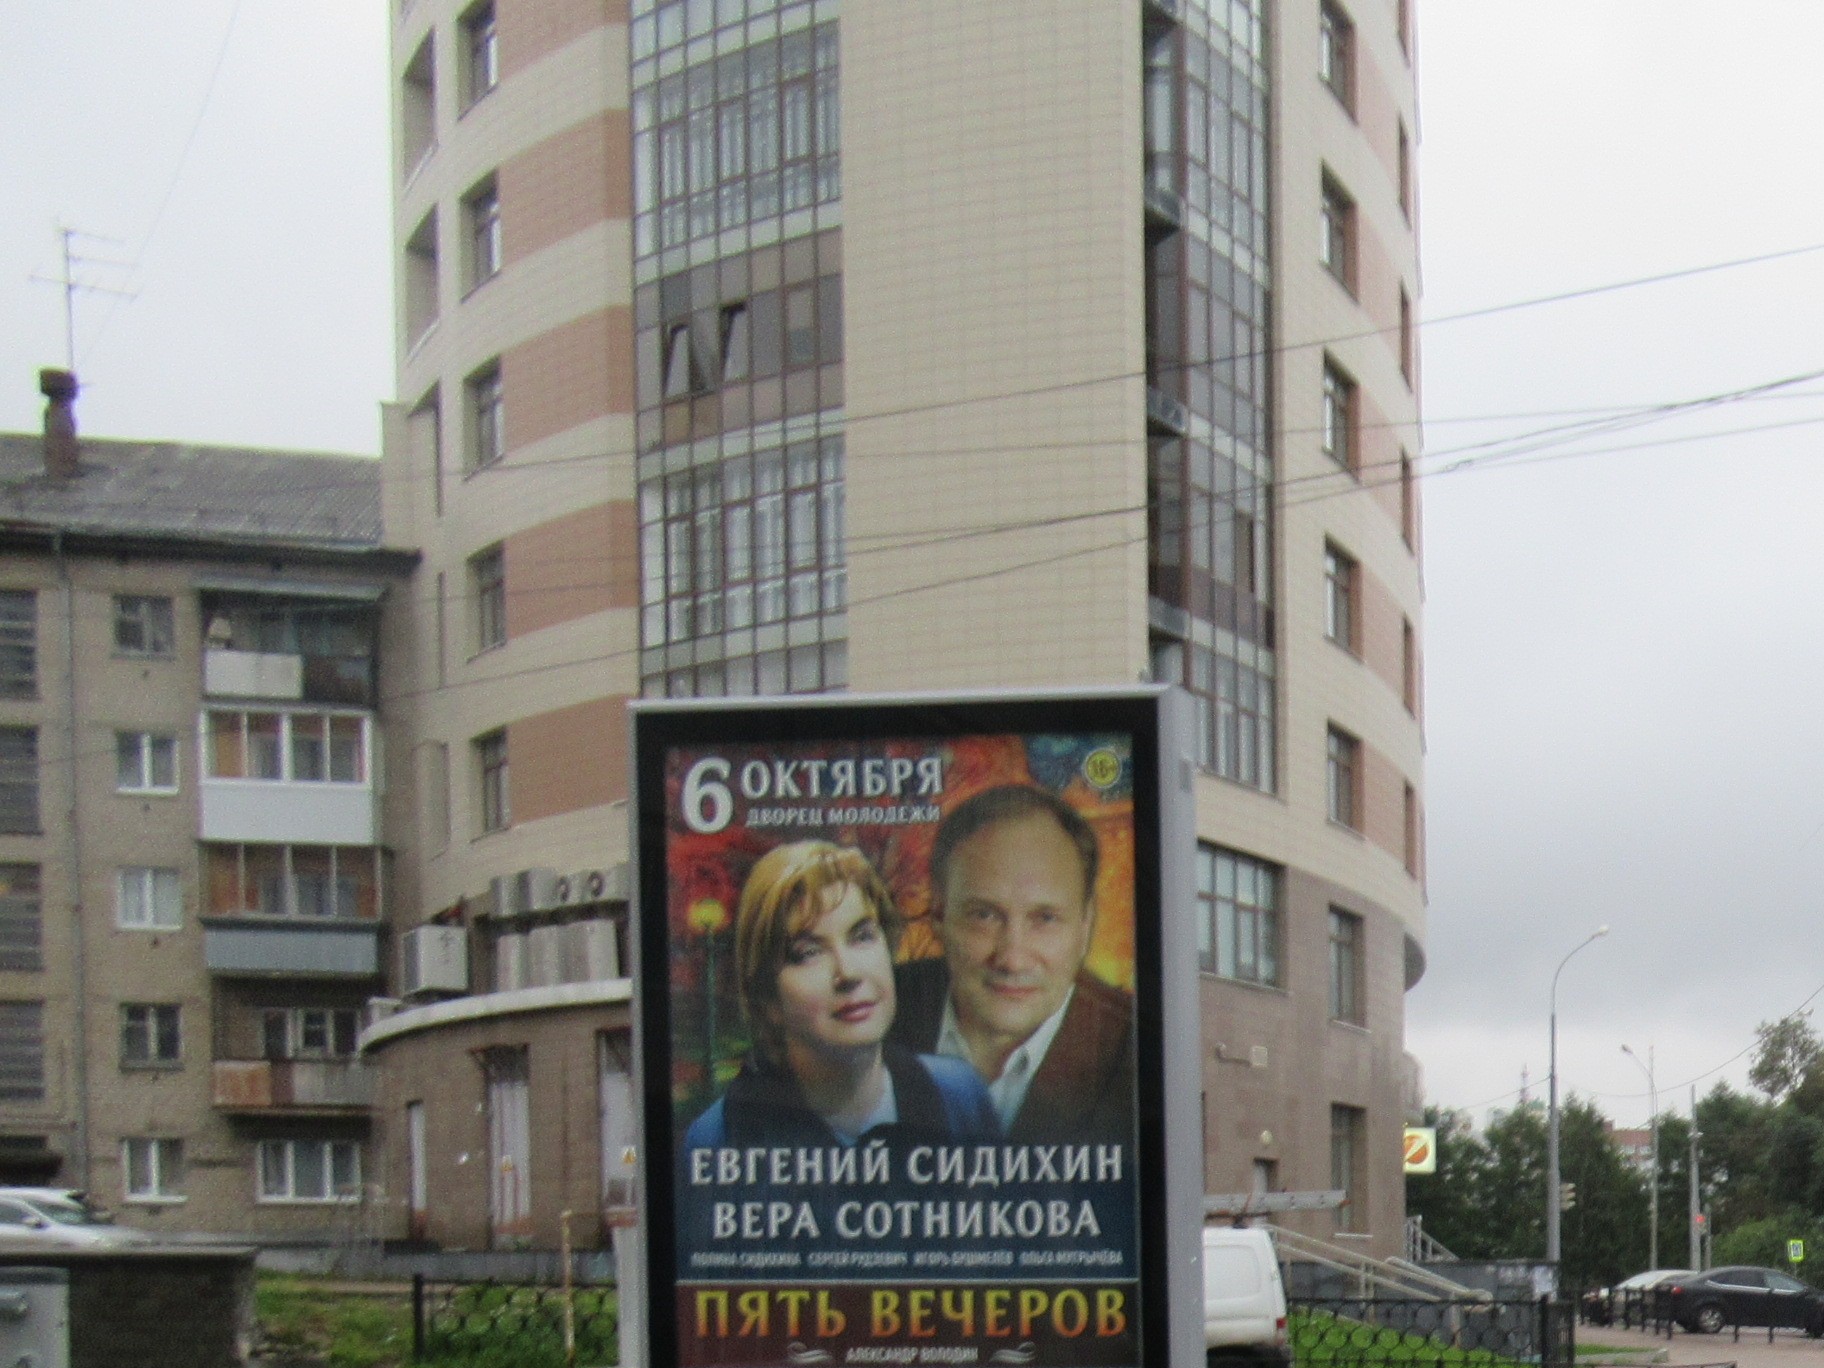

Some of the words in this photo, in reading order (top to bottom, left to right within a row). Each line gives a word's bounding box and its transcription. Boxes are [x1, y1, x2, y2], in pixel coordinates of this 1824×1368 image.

[682, 757, 733, 834] 6
[741, 757, 944, 799] ОКТЯБРЯ
[745, 806, 824, 828] ДВОРЕЦ
[691, 1139, 890, 1185] ЕВГЕНИЙ
[907, 1144, 1123, 1188] СИДИХИН
[713, 1201, 821, 1239] ВЕРА
[835, 1199, 1101, 1239] СОТНИКОВА
[696, 1290, 847, 1338] ПЯТЬ
[871, 1288, 1127, 1338] ВЕЧЕРОВ
[845, 1347, 919, 1364] АЛЕКСАНДР
[920, 1347, 979, 1364] ВОЛОДИН
